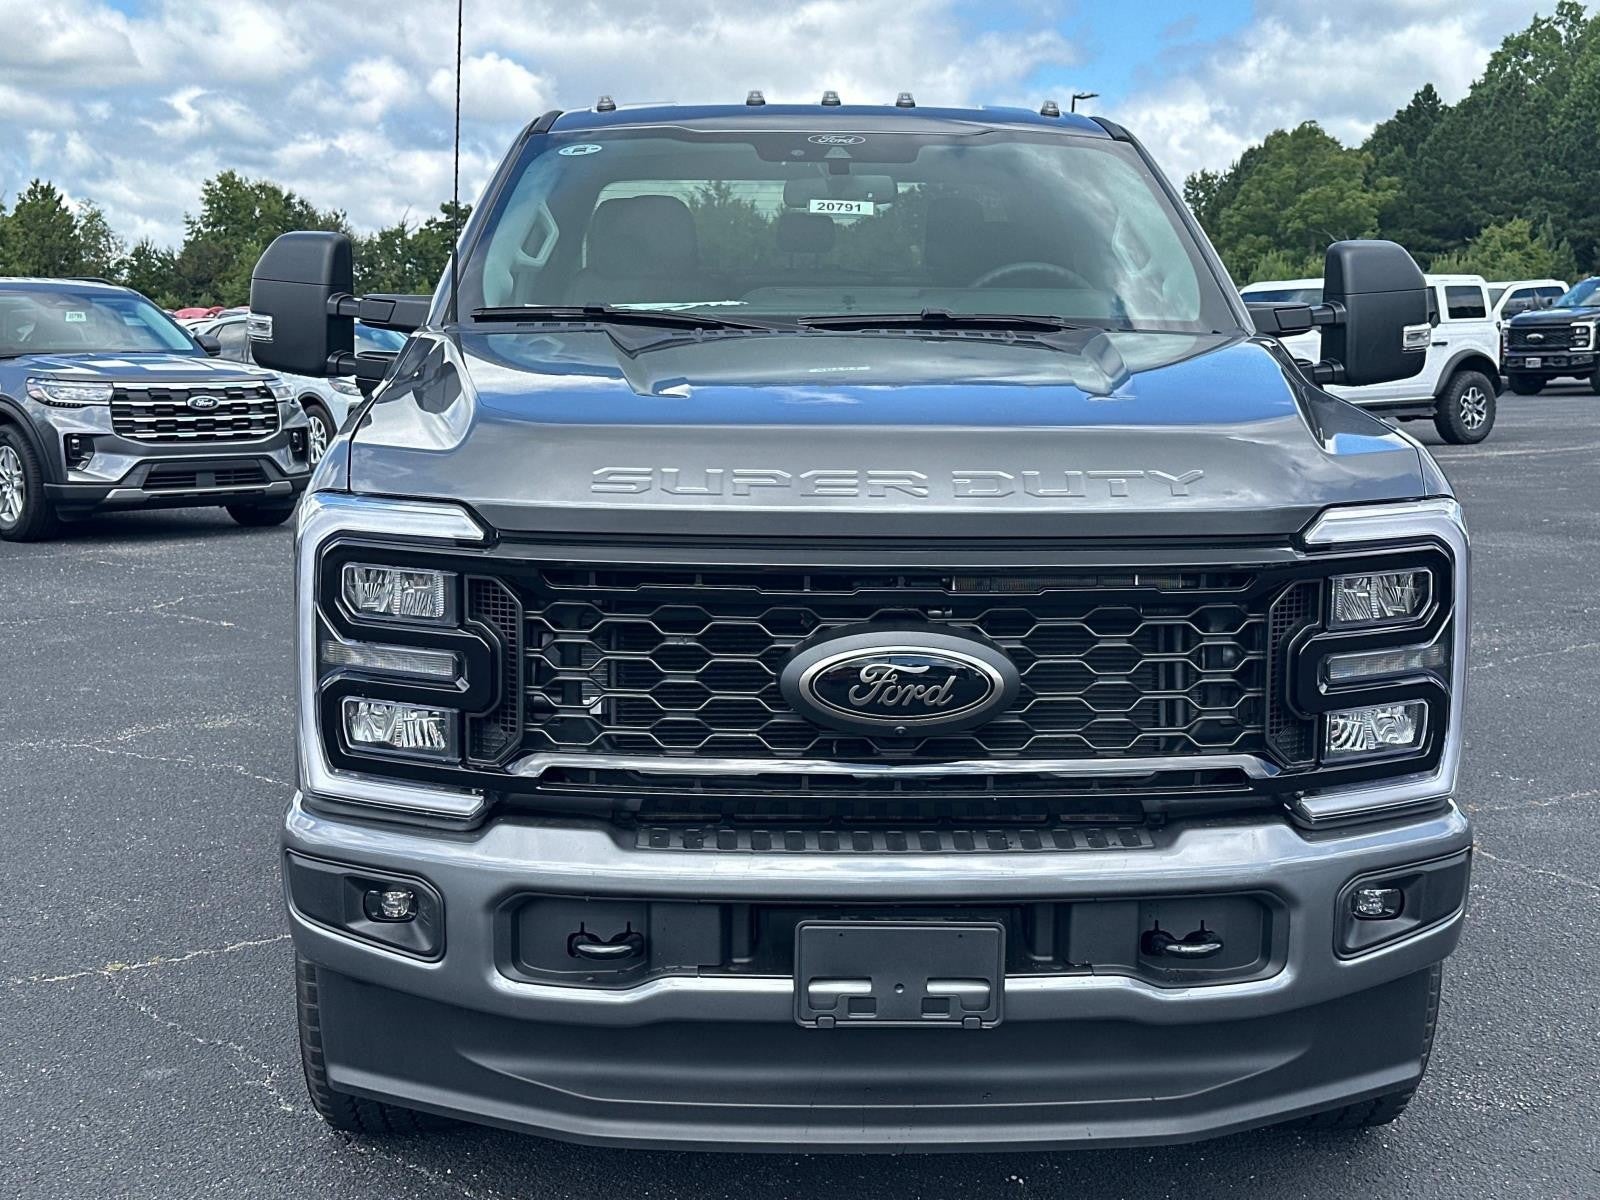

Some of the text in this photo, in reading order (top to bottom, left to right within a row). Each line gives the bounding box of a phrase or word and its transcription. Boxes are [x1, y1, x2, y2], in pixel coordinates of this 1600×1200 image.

[817, 133, 856, 144] Ford
[816, 202, 862, 212] 20791
[591, 466, 1204, 498] SUPER DUTY
[848, 663, 957, 707] Ford
